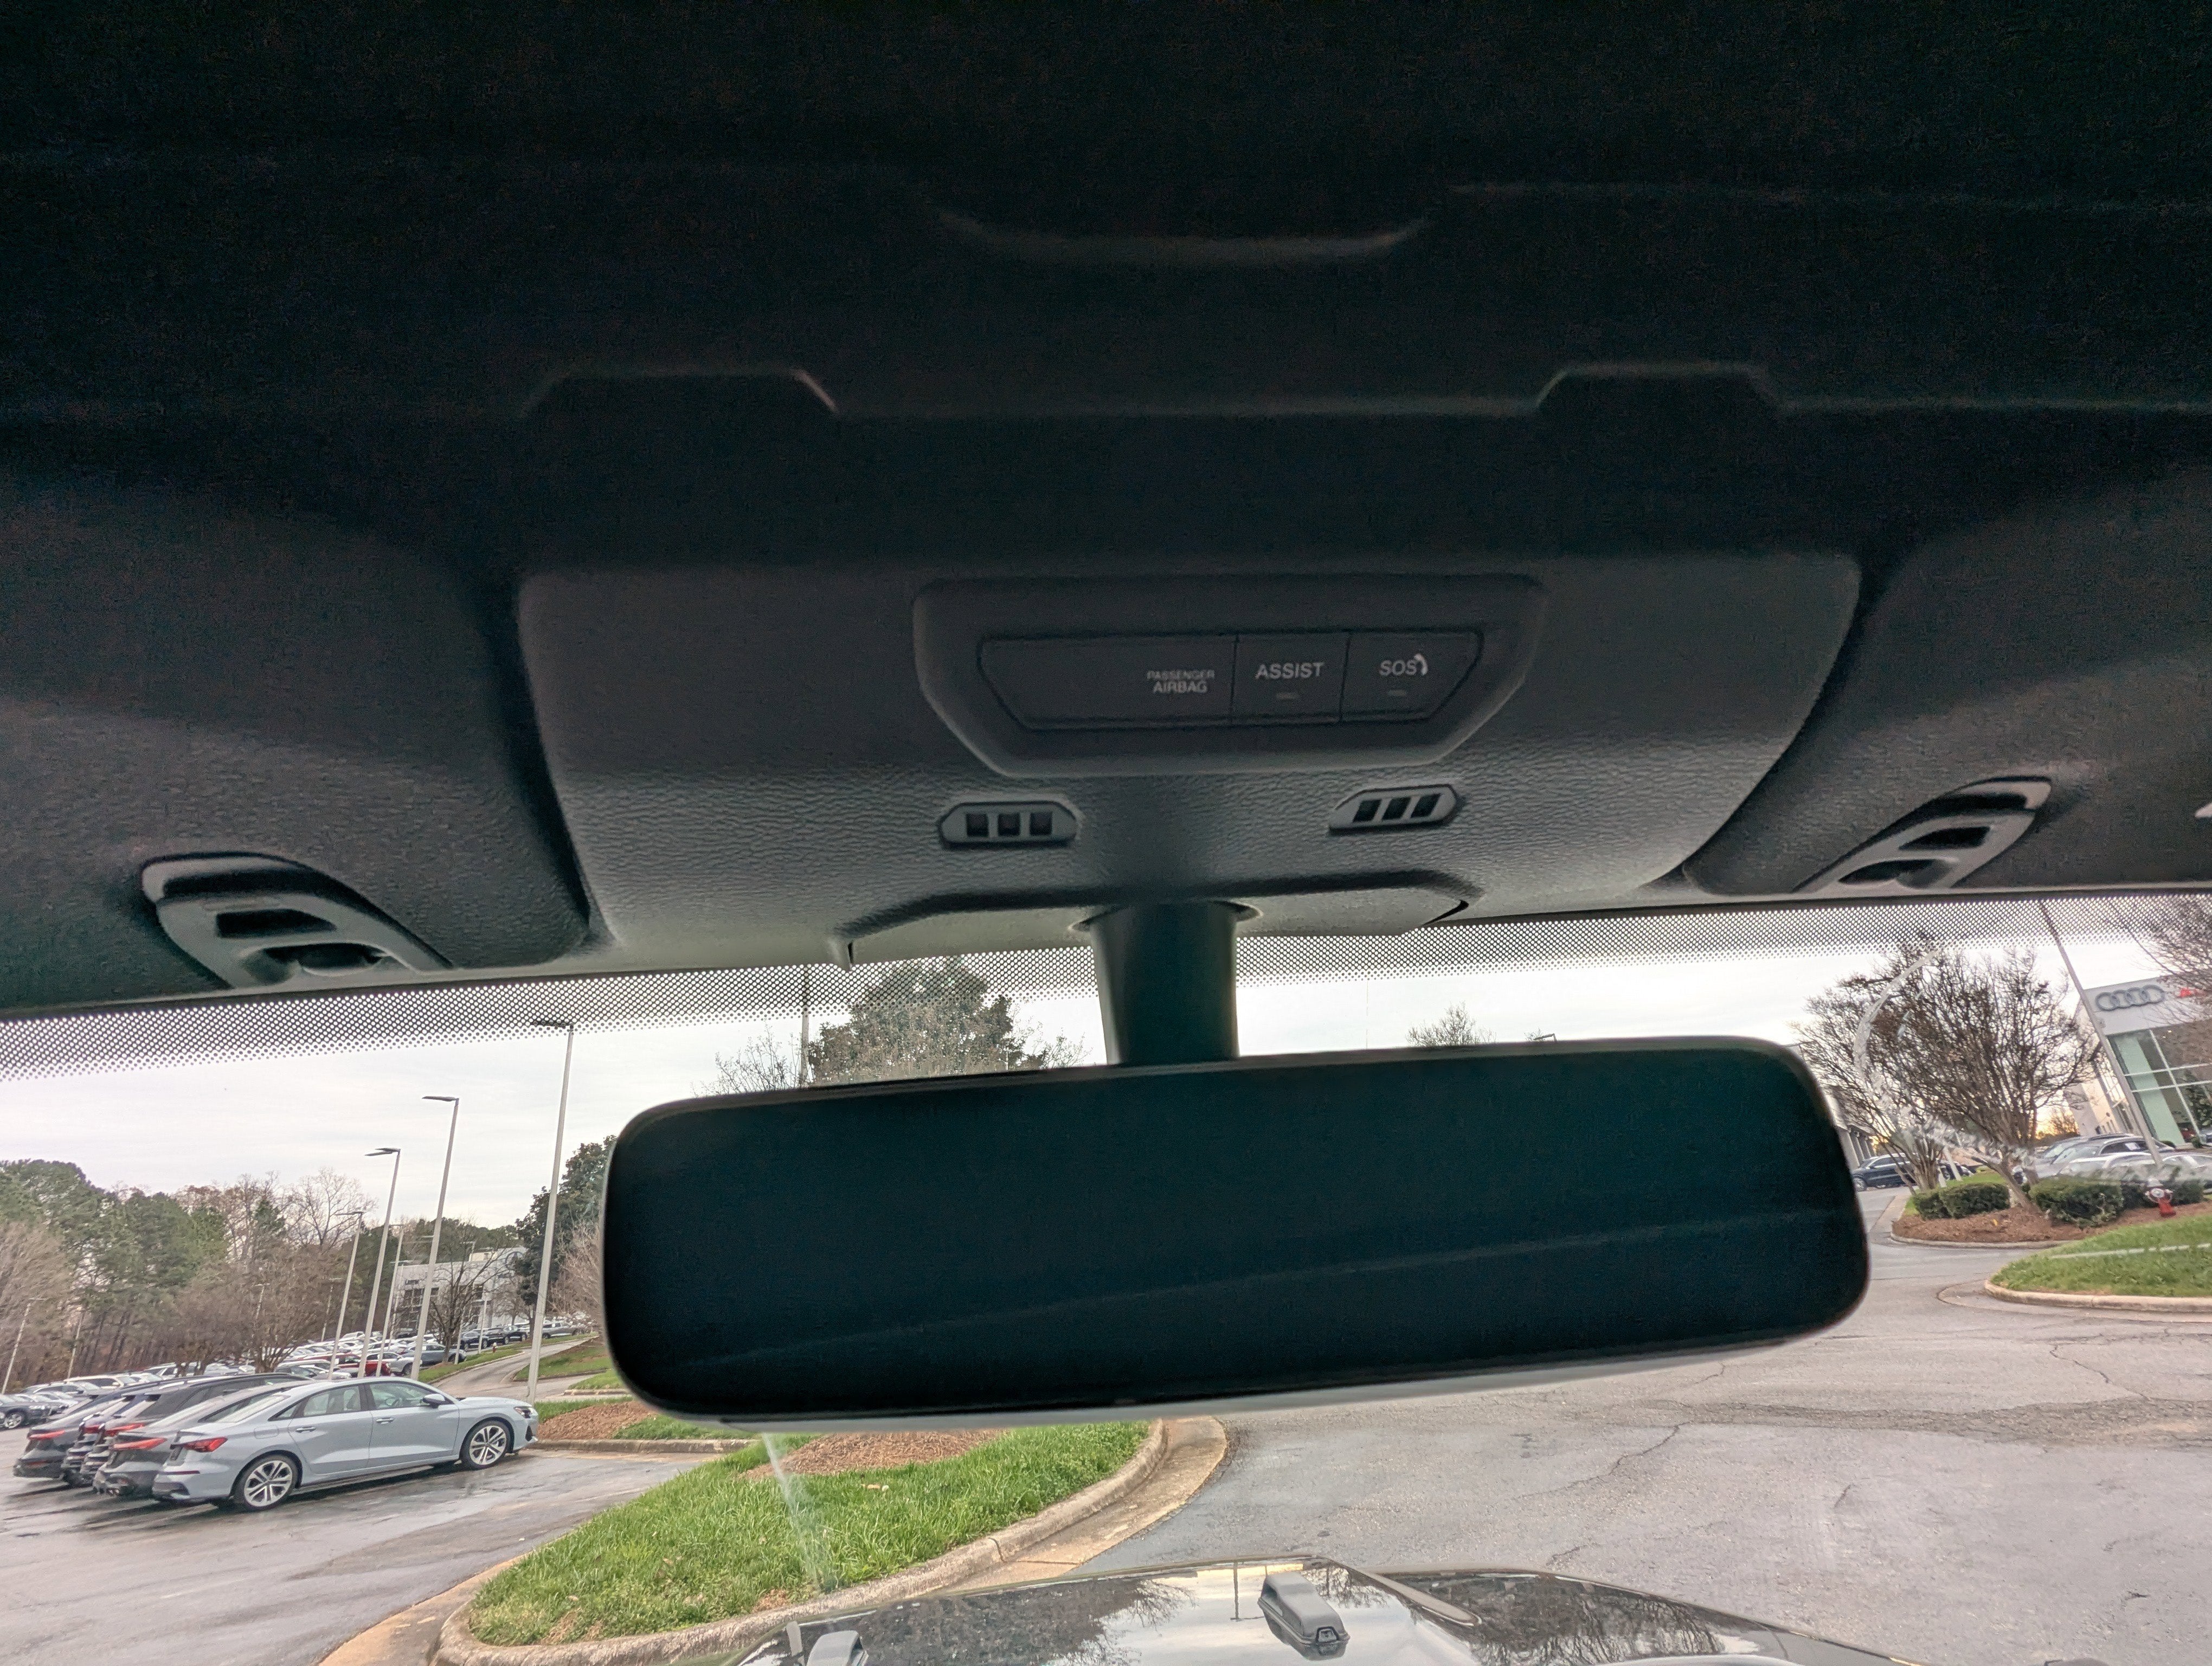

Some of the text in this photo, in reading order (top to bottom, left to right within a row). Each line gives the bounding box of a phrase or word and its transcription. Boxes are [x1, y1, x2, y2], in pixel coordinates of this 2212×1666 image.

[1255, 662, 1324, 678] ASSIST
[1380, 659, 1417, 676] SOS
[1153, 680, 1208, 693] AIRBAG
